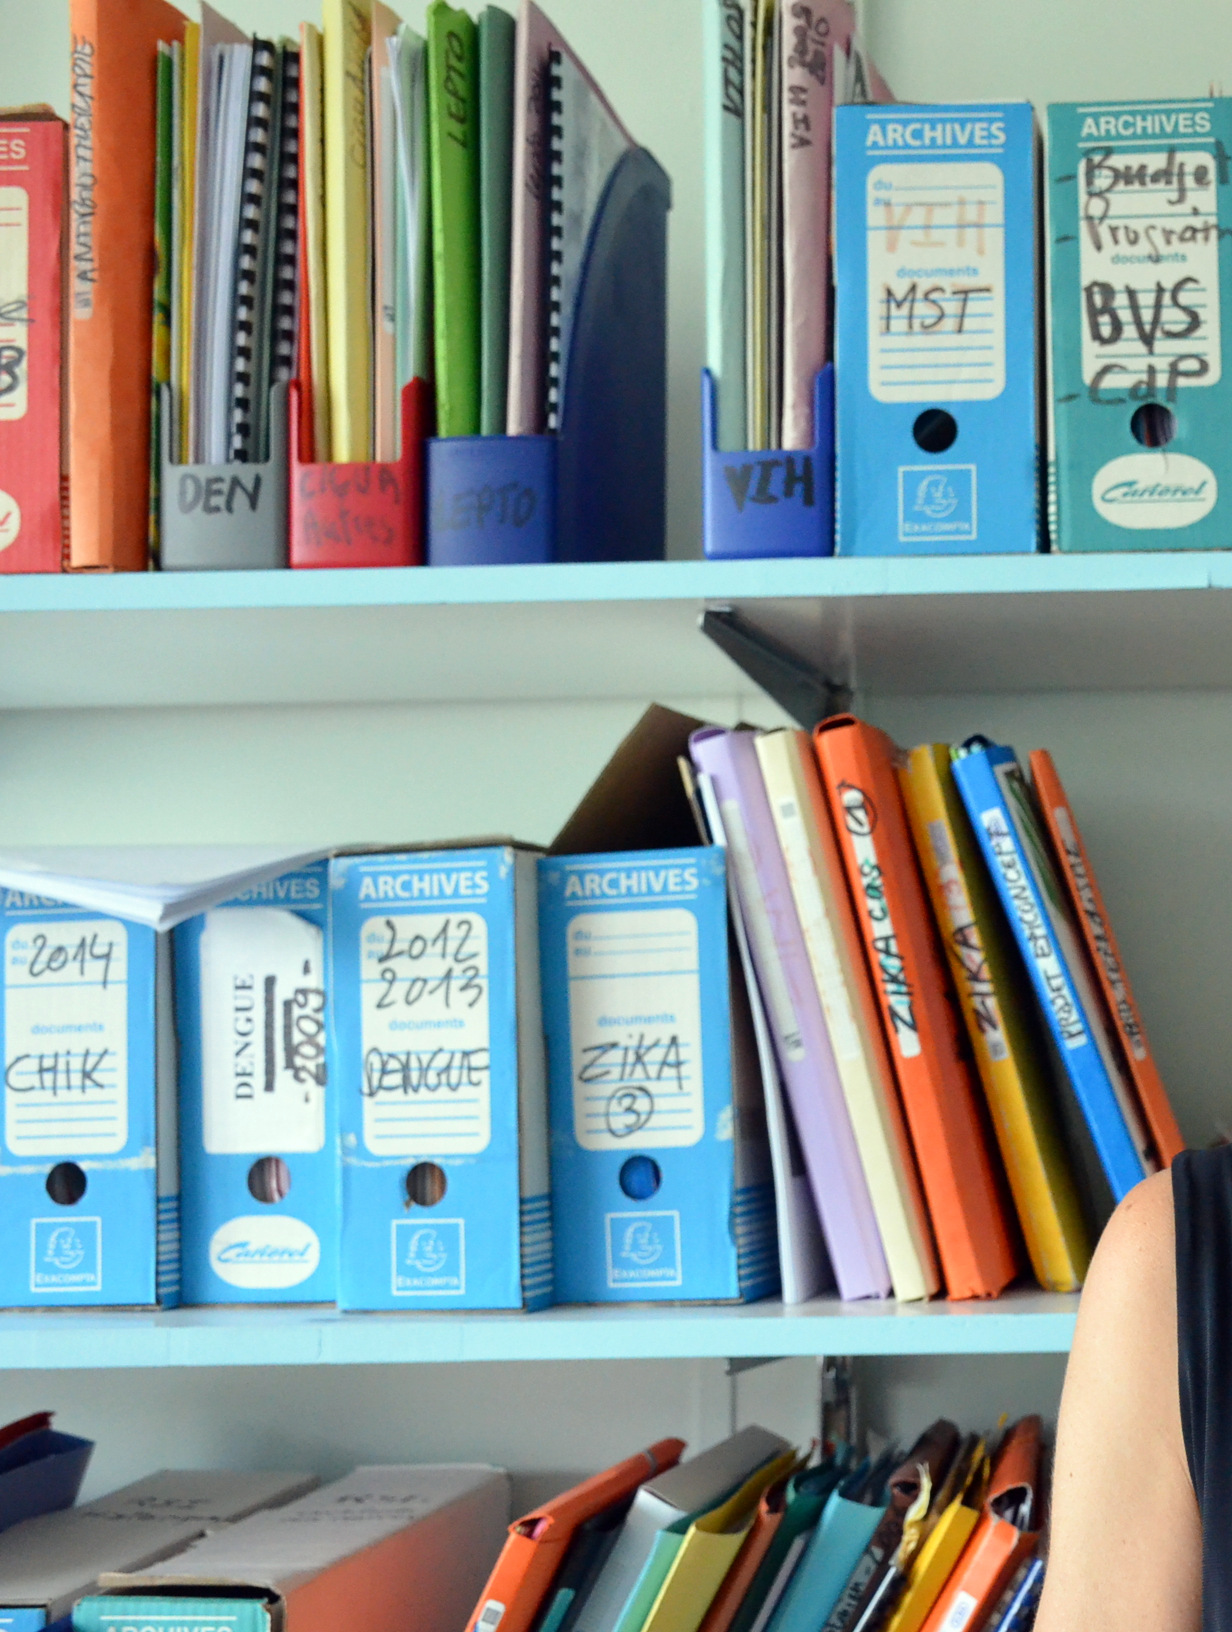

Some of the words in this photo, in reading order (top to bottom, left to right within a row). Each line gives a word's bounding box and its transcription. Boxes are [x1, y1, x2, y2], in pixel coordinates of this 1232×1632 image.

[445, 30, 468, 149] LEPTO
[866, 122, 1006, 147] ARCHIVES
[1081, 111, 1212, 138] ARCHIVES
[884, 196, 986, 256] VIH
[896, 264, 979, 279] documents
[881, 282, 992, 334] MST
[1084, 276, 1202, 355] BVS
[178, 473, 262, 515] DEN
[436, 481, 537, 532] LEPTO
[723, 455, 815, 513] VIH
[1101, 480, 1207, 503] Cartorel
[359, 871, 490, 900] ARCHIVES
[564, 867, 700, 898] ARCHIVES
[29, 933, 114, 990] 2014
[378, 918, 480, 964] 2012
[376, 965, 483, 1009] 2013
[871, 934, 918, 1034] ZIKA
[950, 922, 999, 1034] ZIKA
[30, 1022, 105, 1035] documents
[234, 974, 255, 1100] DENGUE
[388, 1018, 466, 1031] documents
[596, 1013, 676, 1028] documents
[360, 1047, 490, 1098] DENGUE
[217, 1241, 311, 1264] Cartorel
